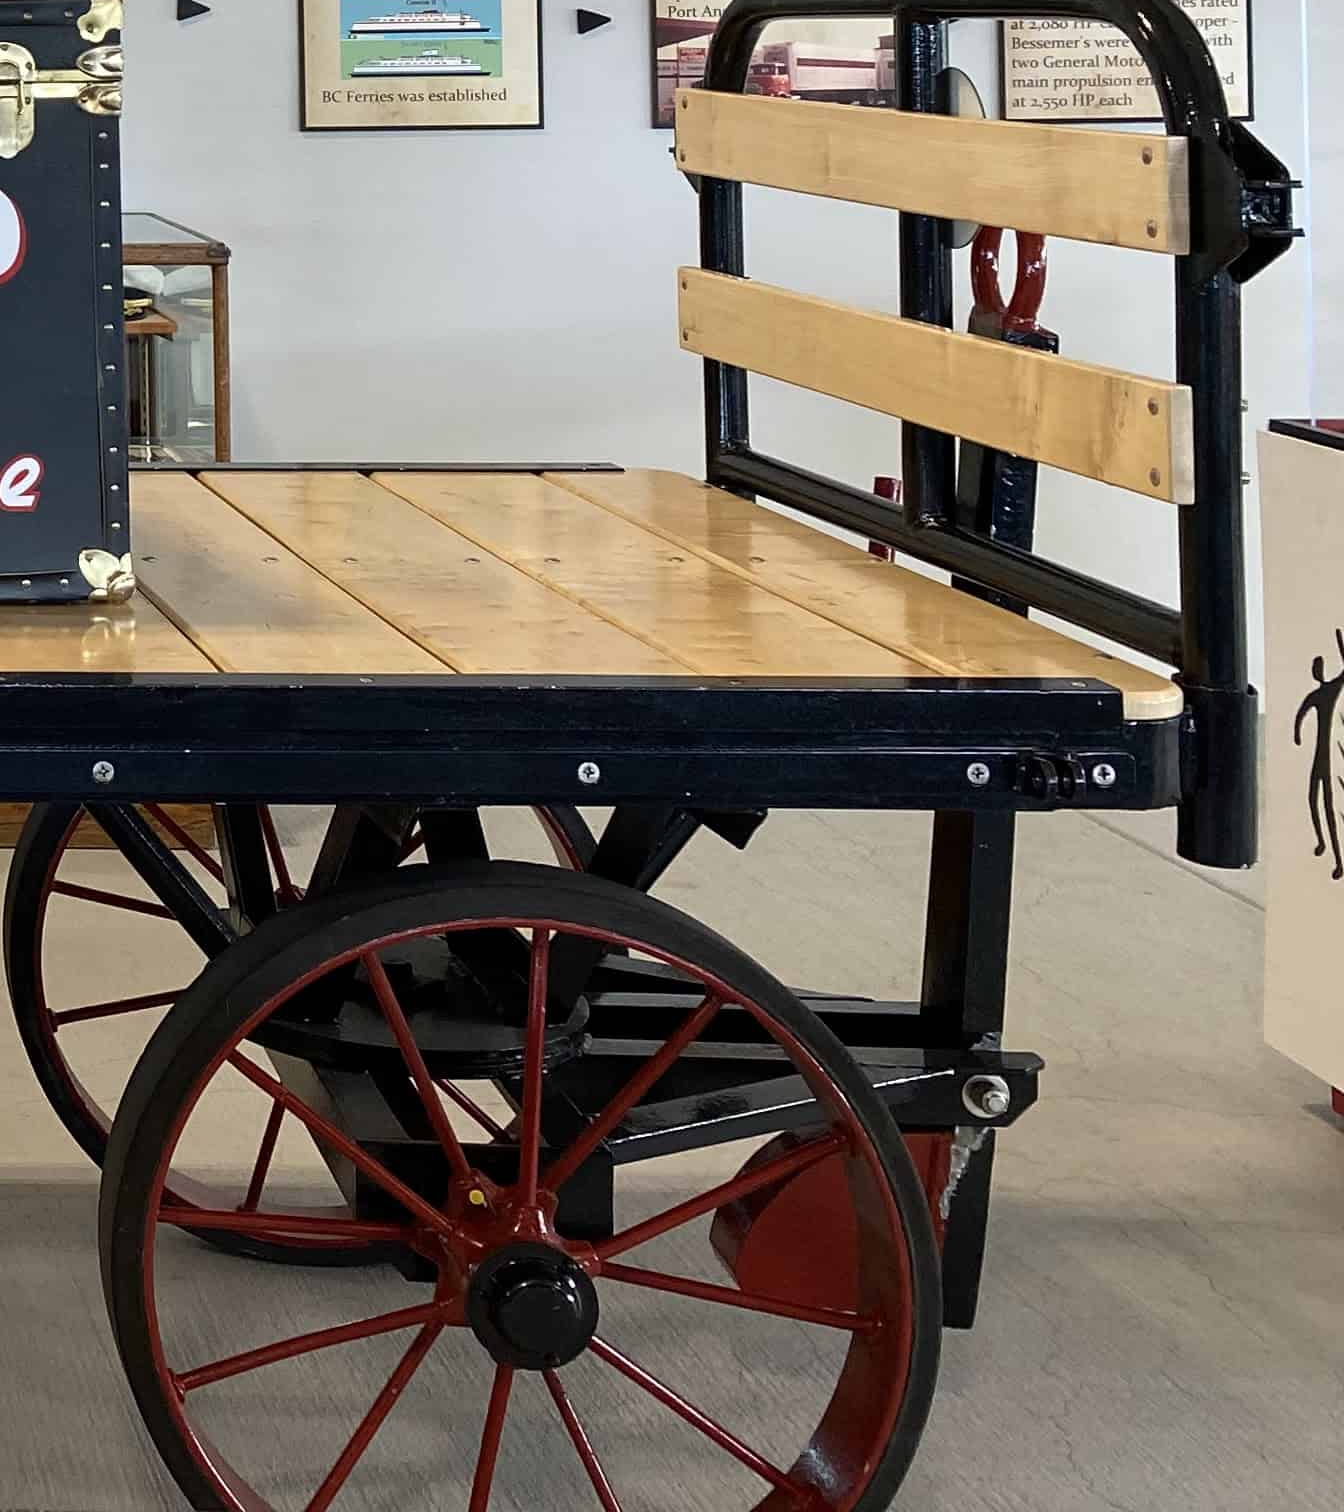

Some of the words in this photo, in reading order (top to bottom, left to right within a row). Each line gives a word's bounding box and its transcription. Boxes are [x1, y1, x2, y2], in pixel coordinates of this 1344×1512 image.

[1010, 35, 1090, 49] Bessemer's
[1094, 38, 1129, 47] were
[321, 90, 341, 103] BC
[346, 89, 394, 103] Ferries
[397, 92, 424, 102] was
[428, 88, 506, 101] established
[1012, 97, 1026, 107] at
[1030, 97, 1068, 110] 2,550
[1072, 94, 1095, 106] HP
[1098, 93, 1132, 106] each
